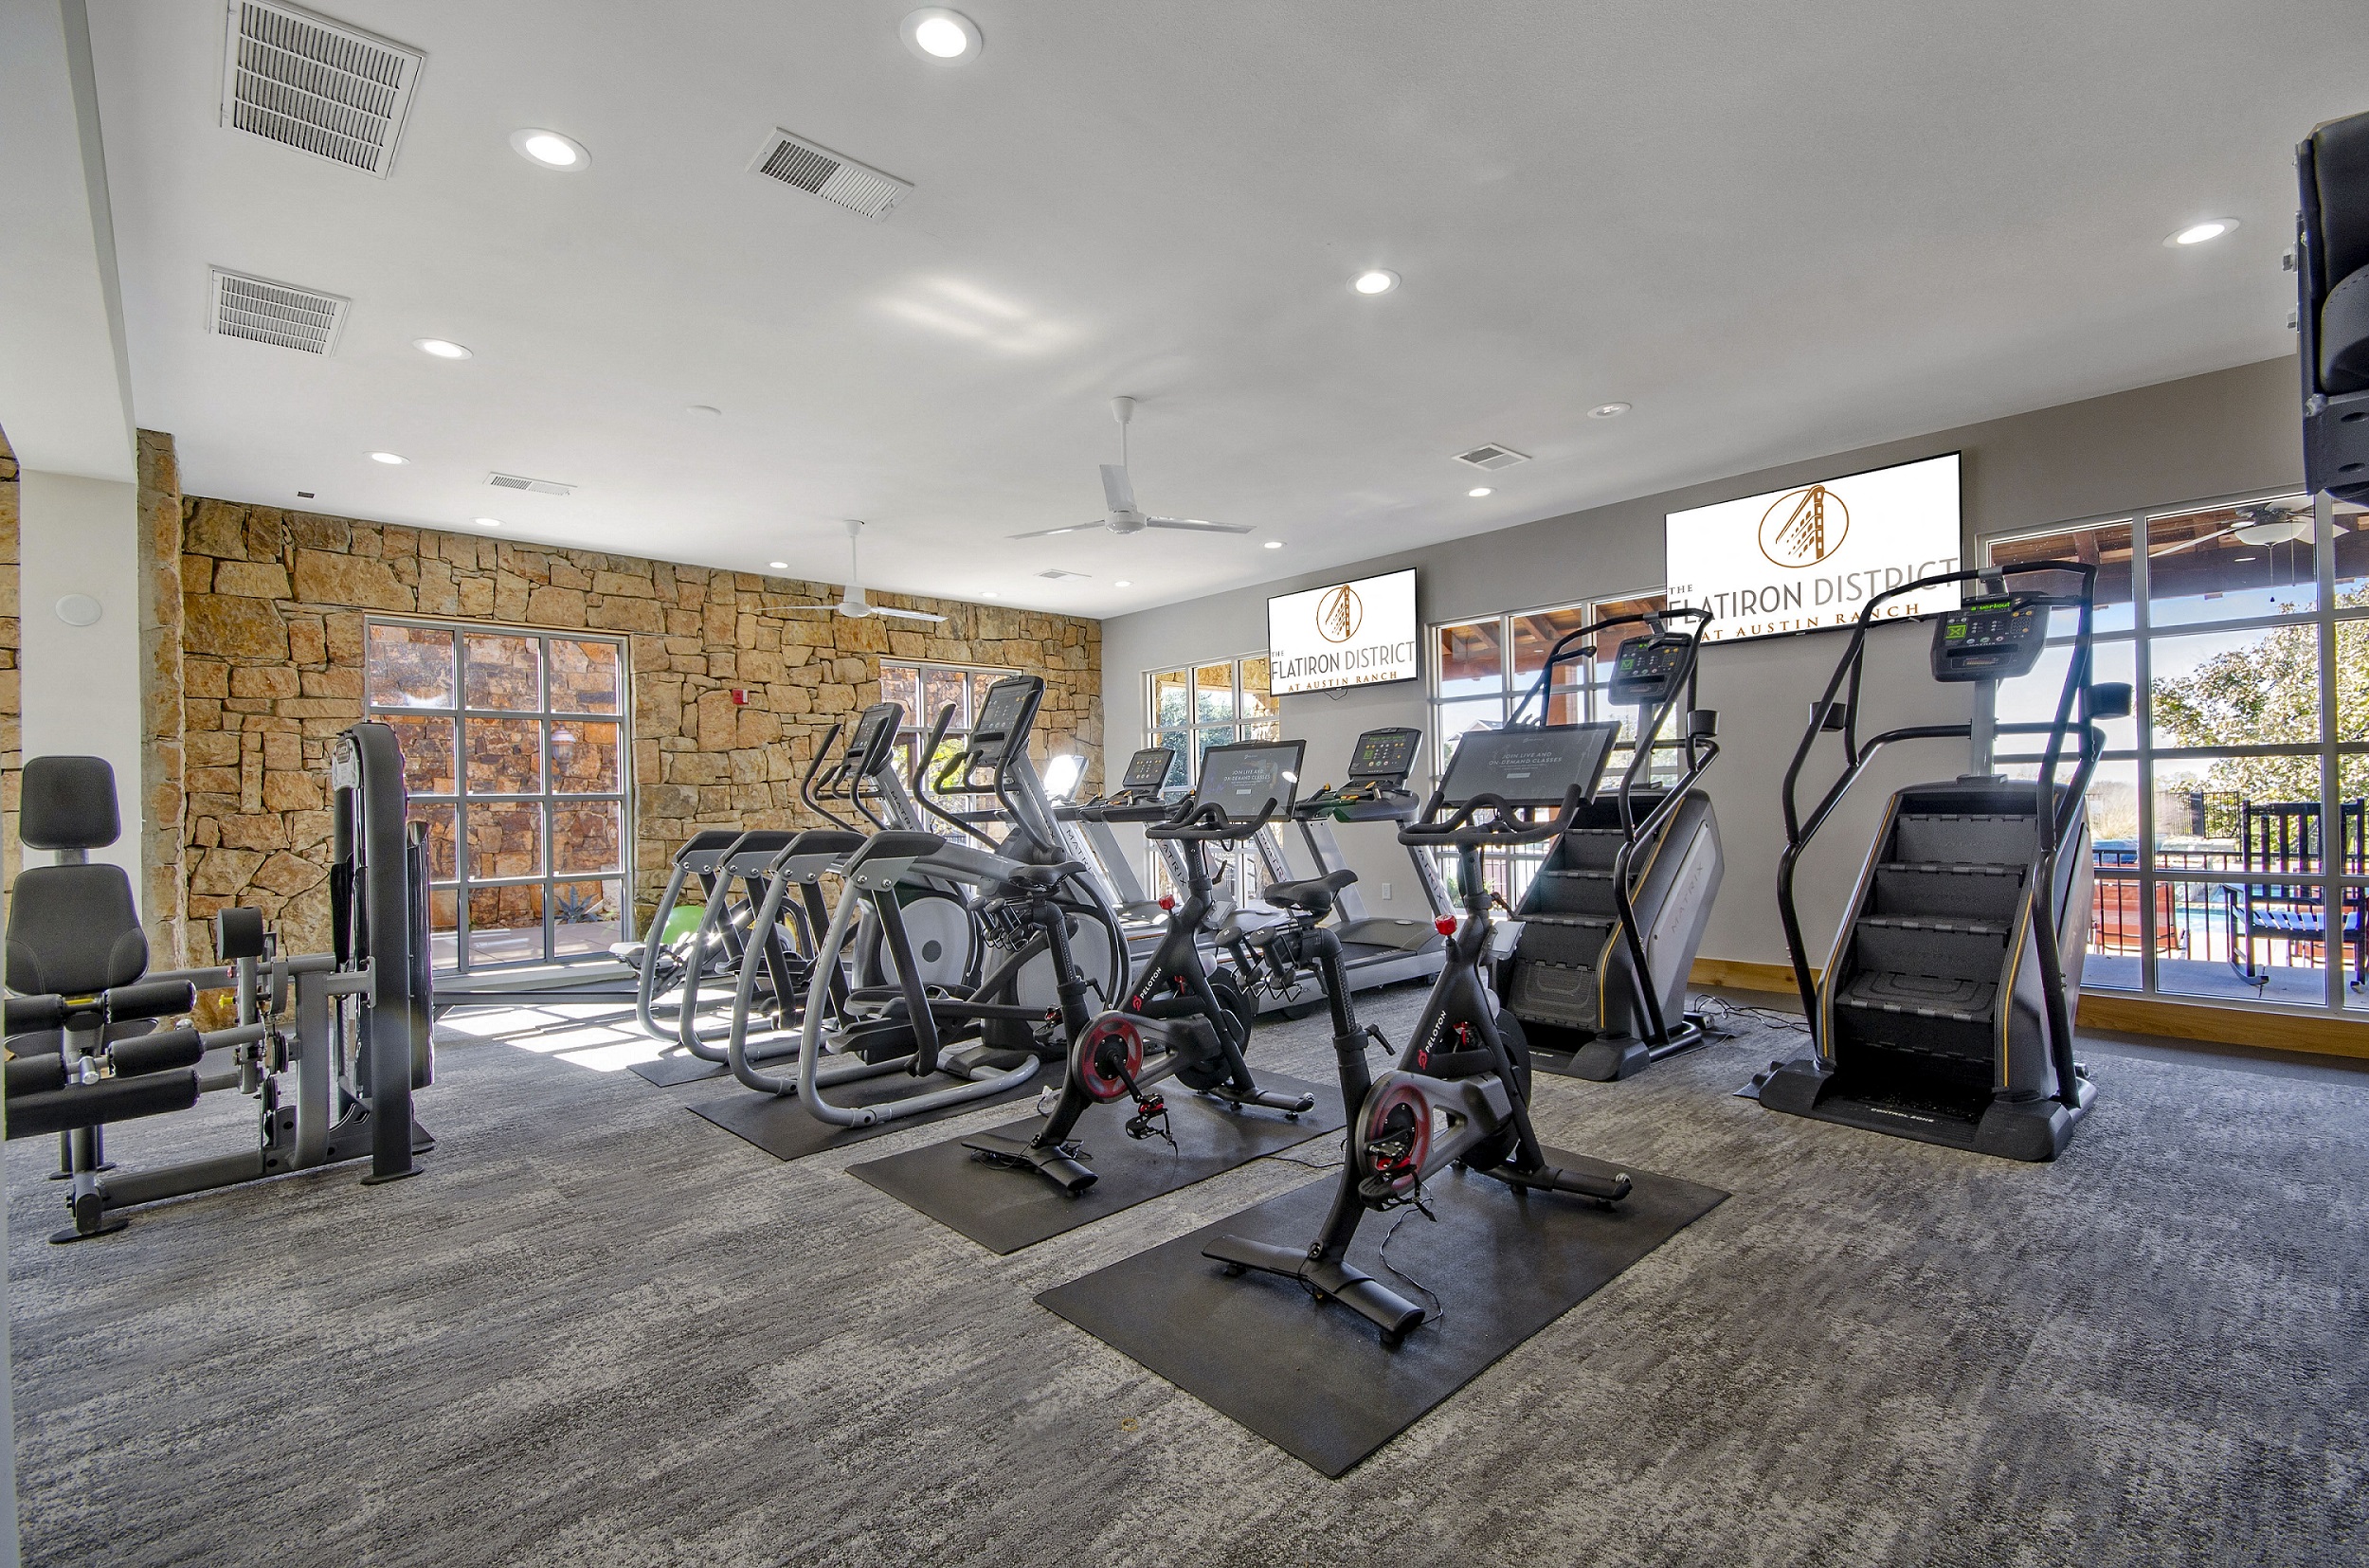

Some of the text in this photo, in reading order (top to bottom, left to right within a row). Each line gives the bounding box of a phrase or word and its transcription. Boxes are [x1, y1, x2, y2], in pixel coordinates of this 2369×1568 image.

[1669, 585, 1692, 595] THE
[1669, 557, 1959, 626] FLATIRON DISTRICT
[1701, 604, 1919, 641] AT AUSTIN RANCH
[1272, 641, 1415, 680] FLATIRON DISTRICT
[1289, 671, 1398, 692] AT AUSTIN RANCH
[891, 790, 913, 830] MATRI
[1159, 838, 1187, 887] ATRIX
[1417, 846, 1443, 903] ATRIX
[1671, 862, 1703, 934] MATRIX
[1140, 966, 1162, 1000] PELOTON
[1424, 1010, 1447, 1054] PELOTON
[1871, 1108, 1908, 1118] CONTROL
